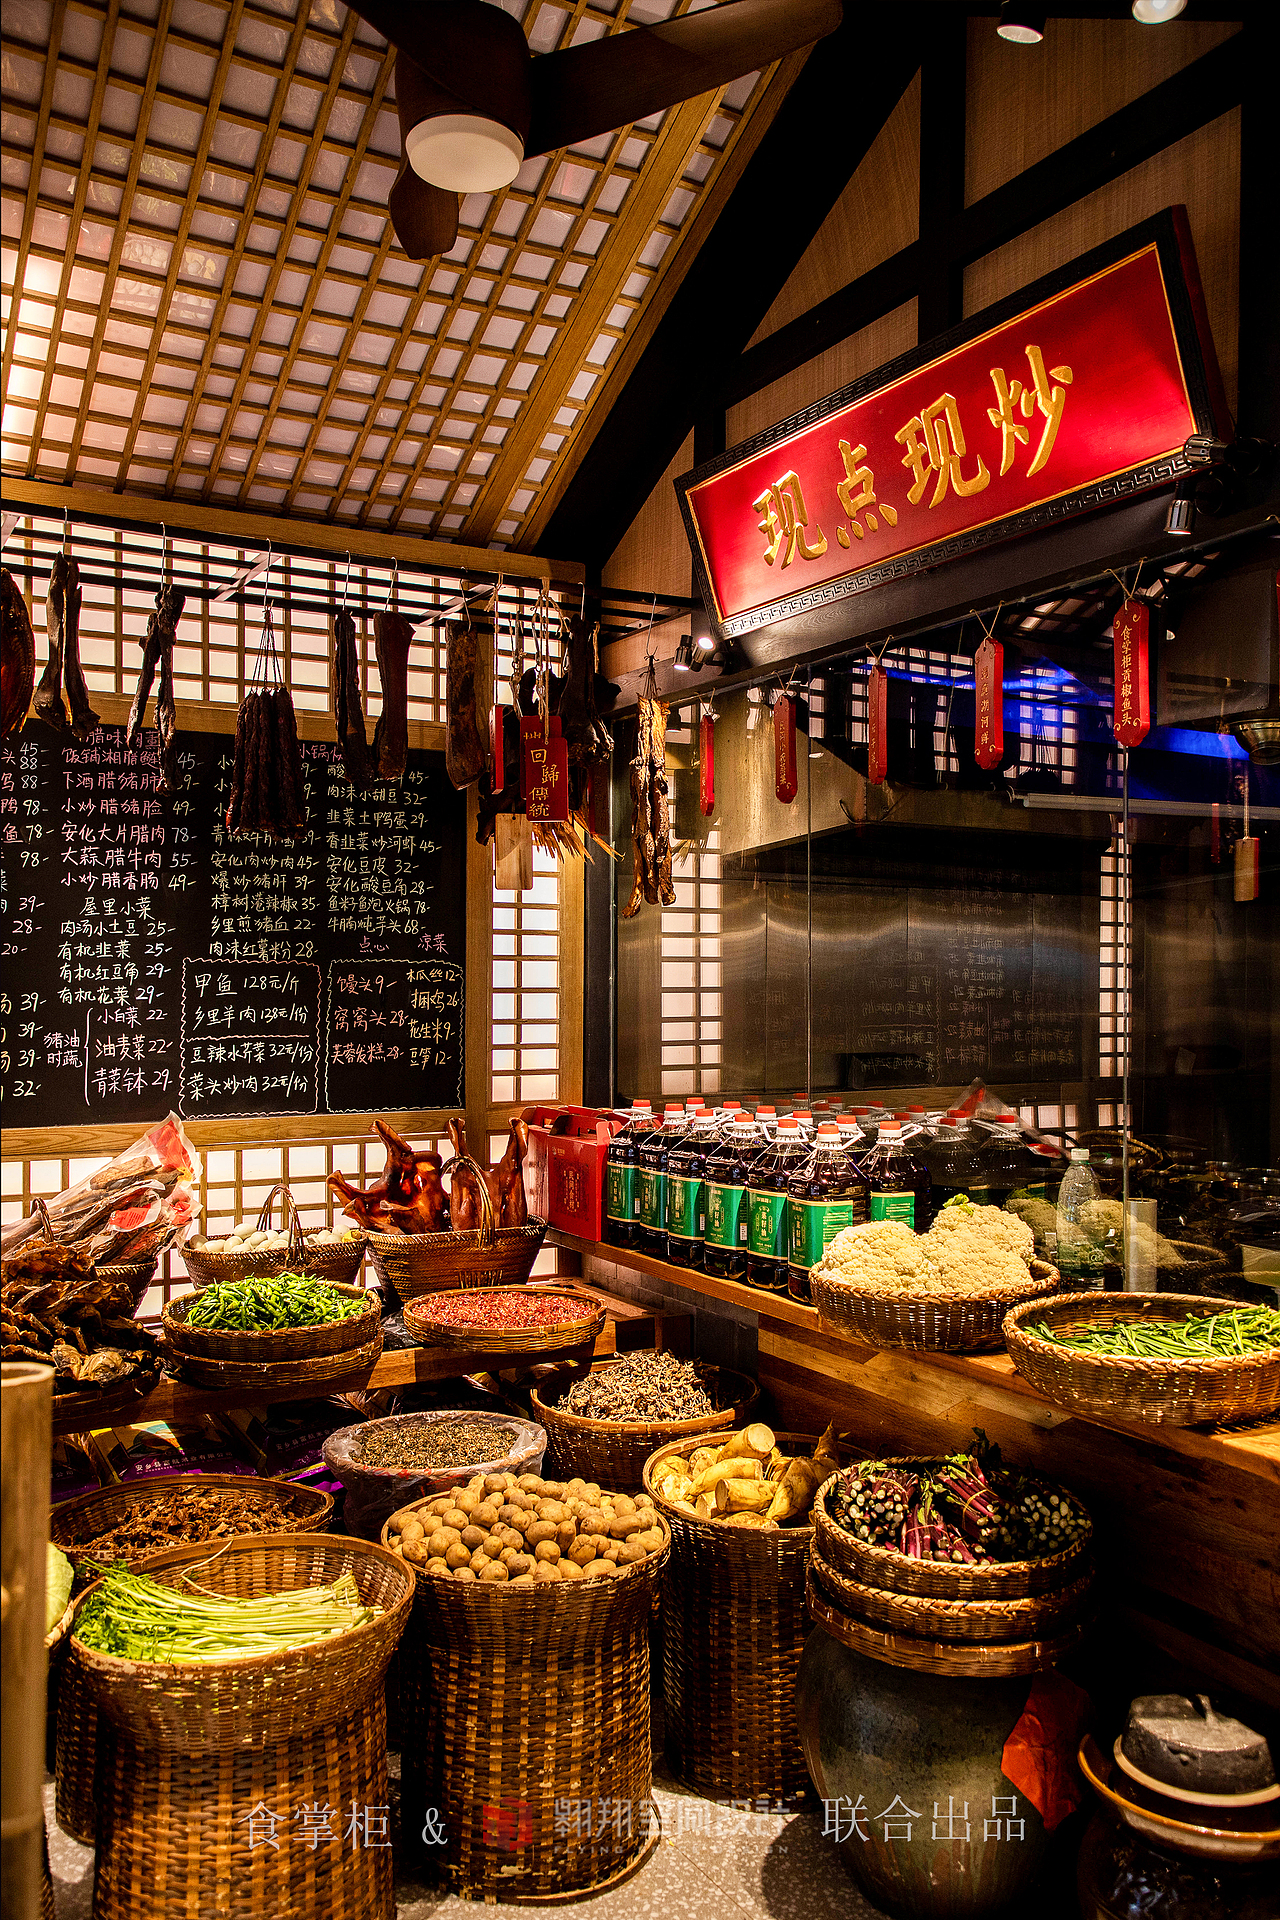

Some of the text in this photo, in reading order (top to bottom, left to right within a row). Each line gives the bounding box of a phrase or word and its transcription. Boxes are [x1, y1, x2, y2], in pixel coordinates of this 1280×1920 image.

[752, 344, 1074, 570] 现点现炒
[61, 798, 164, 819] 小炒腊猪脸
[326, 807, 409, 830] 韭菜土鸭蛋
[61, 821, 165, 845] 安化大片腊肉
[326, 831, 416, 856] 香韭菜炒河虾
[61, 846, 161, 870] 大蒜腊牛肉
[326, 854, 389, 877] 安化豆皮
[61, 872, 159, 892] 小炒腊香肠
[211, 870, 287, 893] 爆炒猪肝
[325, 875, 408, 896] 安化酸豆角
[79, 896, 155, 920] 屋里小菜
[211, 891, 299, 912] 樟树港辣椒
[328, 894, 411, 916] 鱼籽鱼泡火锅
[61, 920, 139, 937] 肉汤小土豆
[211, 914, 290, 937] 乡里煎猪血
[327, 914, 402, 936] 牛腩炖芋头
[57, 940, 131, 960] 有机韭菜
[209, 938, 291, 961] 肉沫红薯粉
[359, 935, 390, 953] 点心
[417, 932, 449, 955] 凉菜
[59, 962, 139, 985] 有机红豆角
[194, 972, 238, 998] 甲鱼
[337, 973, 373, 995] 馒头
[57, 985, 130, 1006] 有机花菜
[97, 1006, 141, 1028] 小白菜
[192, 1005, 256, 1031] 乡里羊肉
[334, 1005, 387, 1032] 窝窝头
[43, 1029, 80, 1049] 猪油
[407, 1018, 443, 1044] 花生米
[95, 1033, 146, 1061] 油麦菜
[268, 1042, 314, 1064] 32元/份
[331, 1042, 386, 1065] 芙蓉发糕
[47, 1050, 83, 1068] 时蔬
[91, 1067, 148, 1098] 青菜钵
[187, 1070, 309, 1101] 菜头炒肉 32元/份
